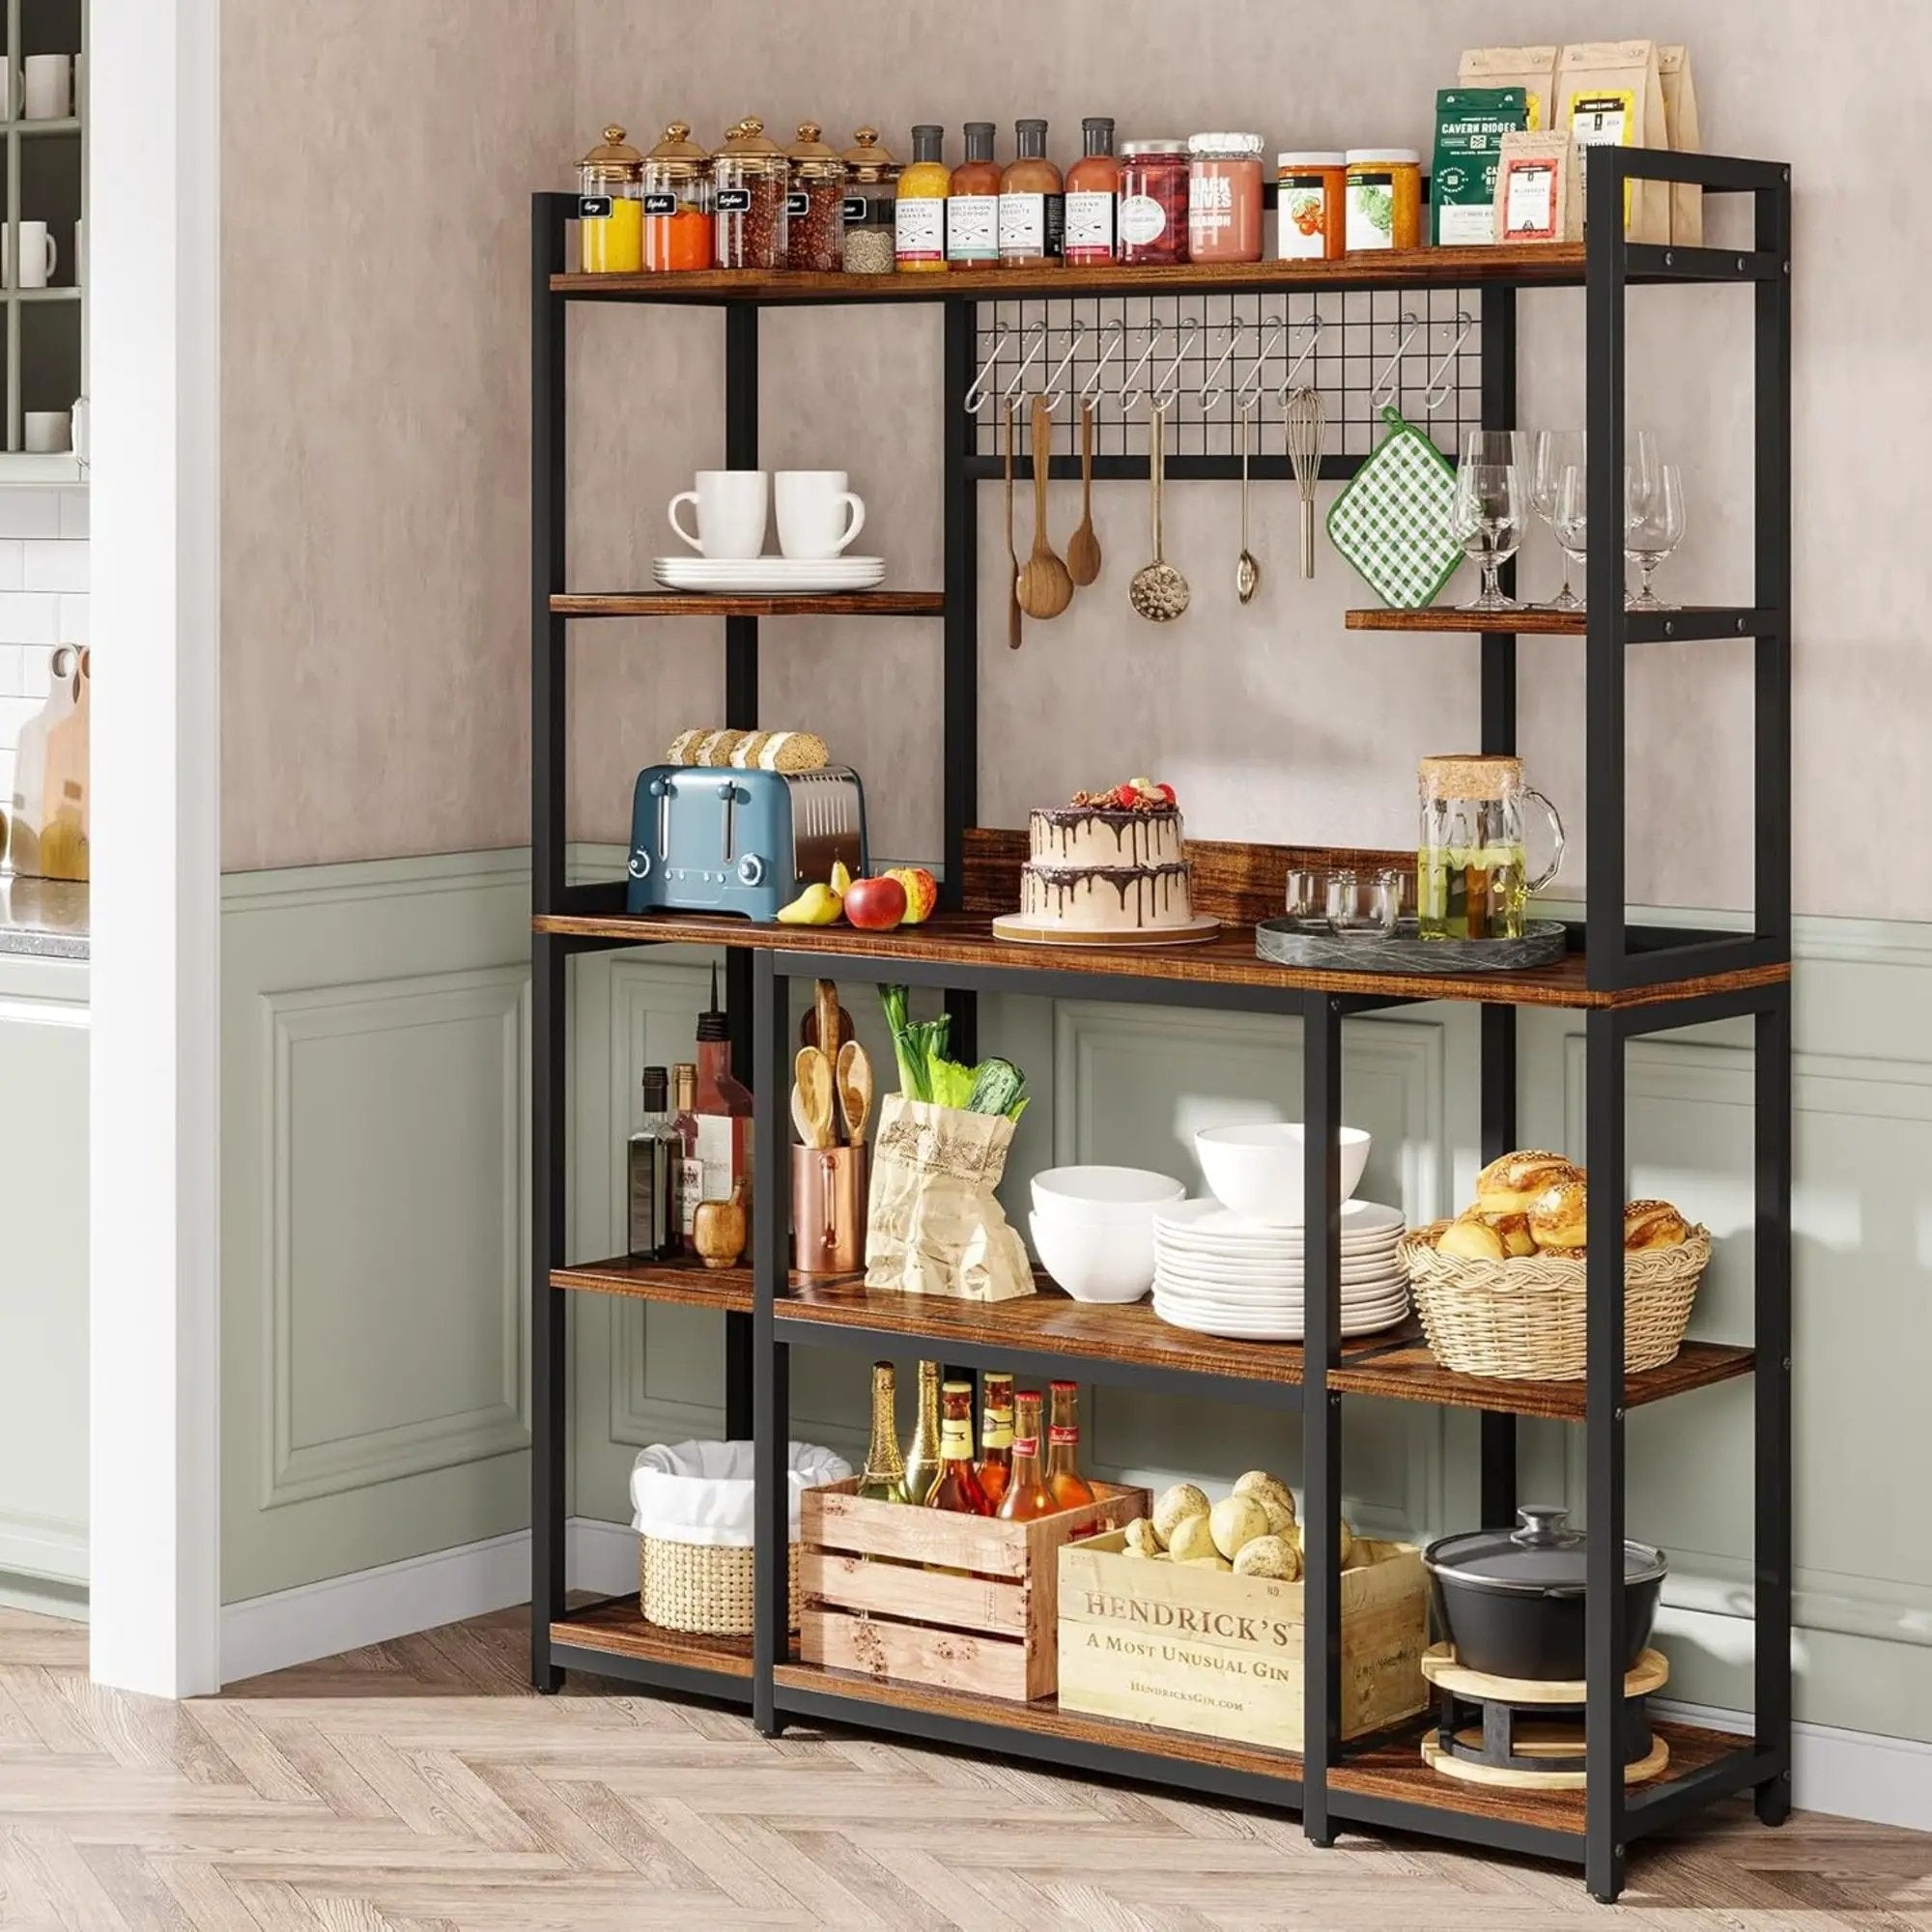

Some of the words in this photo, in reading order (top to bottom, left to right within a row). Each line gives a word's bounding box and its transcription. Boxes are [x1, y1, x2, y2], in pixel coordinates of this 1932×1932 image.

[1441, 123, 1480, 134] CAVERN
[1481, 123, 1517, 133] RIDGES
[1086, 1593, 1289, 1646] HENDRICK'S
[1087, 1633, 1100, 1648] A
[1106, 1636, 1156, 1658] MOST
[1162, 1646, 1247, 1674] UNUSUAL
[1252, 1662, 1290, 1682] GIN
